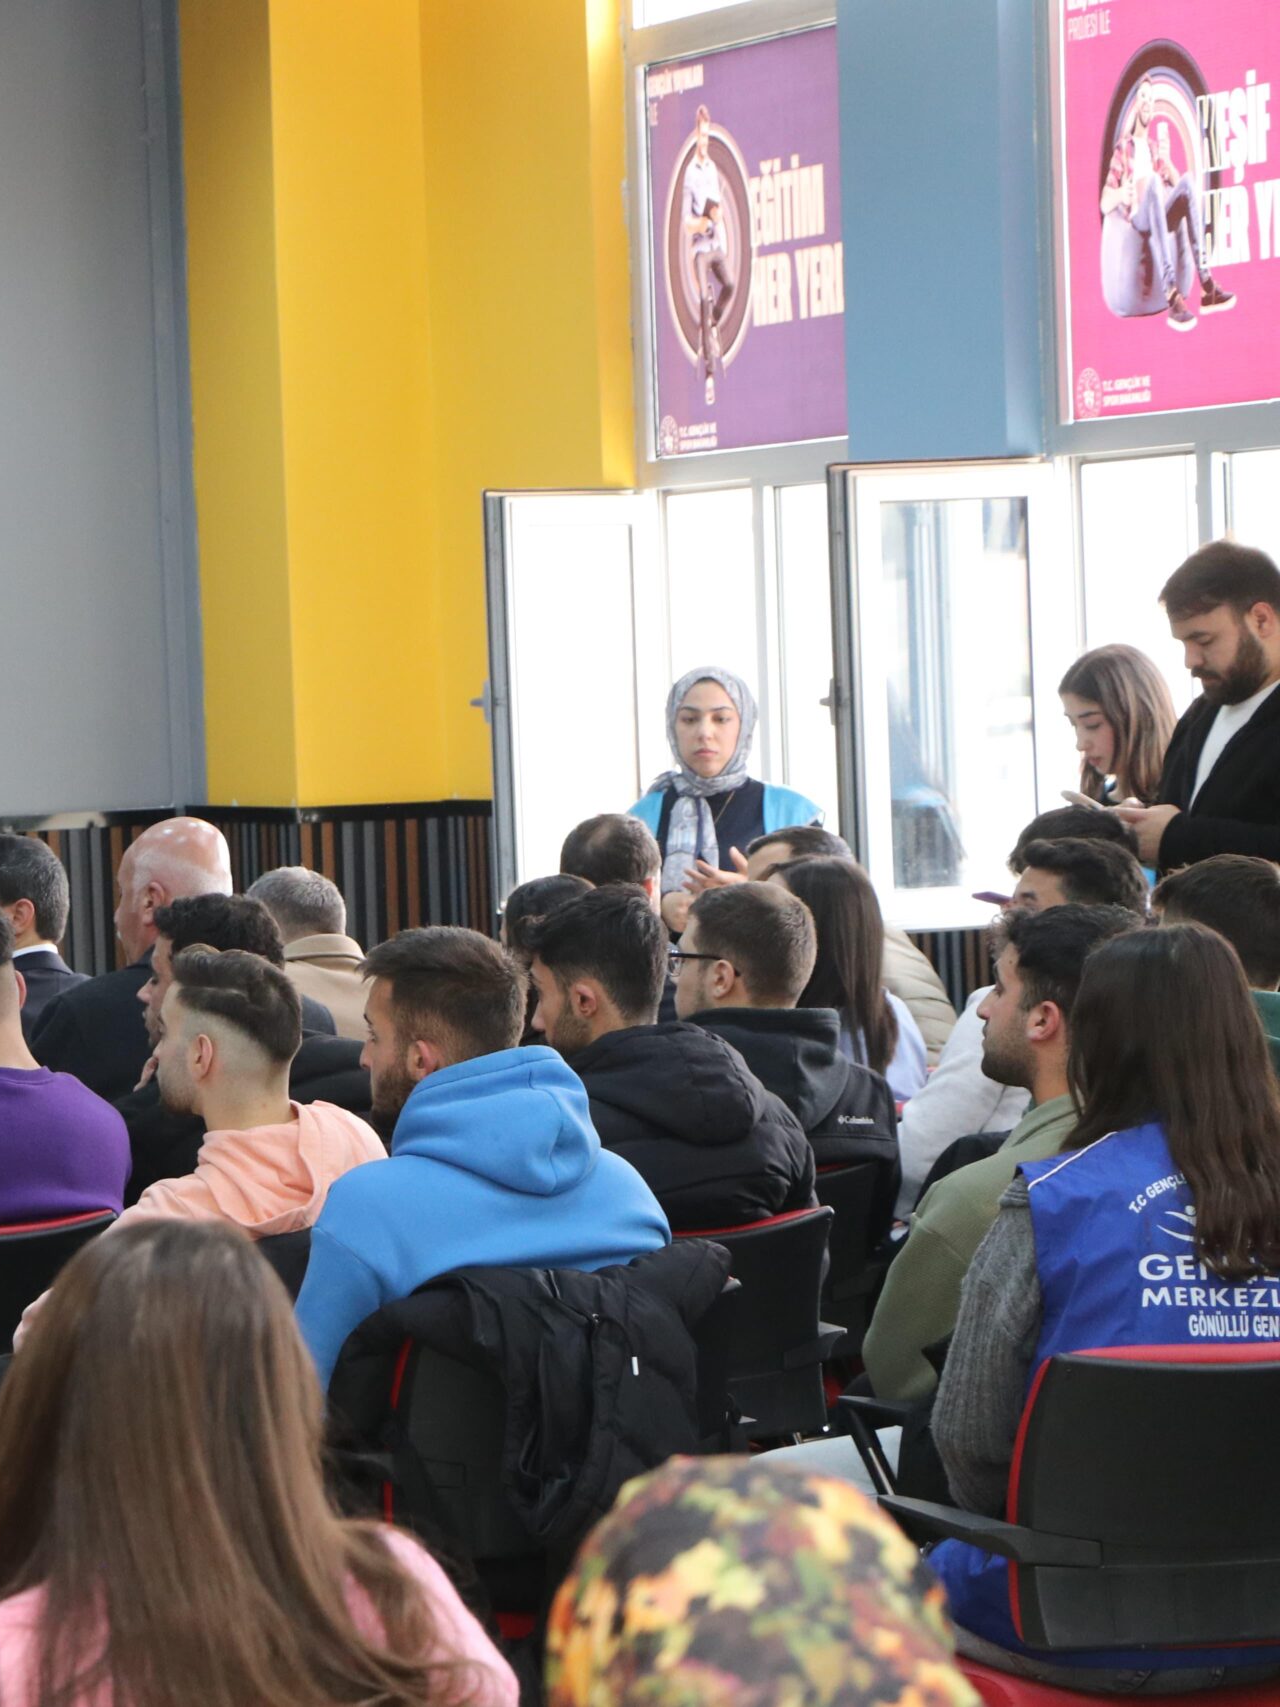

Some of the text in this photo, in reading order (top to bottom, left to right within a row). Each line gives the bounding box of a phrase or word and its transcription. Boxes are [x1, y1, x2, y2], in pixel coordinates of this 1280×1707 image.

[1196, 69, 1271, 184] KEŞİF
[749, 153, 825, 247] EĞİTİM
[1199, 185, 1251, 269] HER
[752, 251, 793, 328] HER
[1128, 1194, 1147, 1214] T.C
[1188, 1309, 1250, 1338] GÖNÜLLÜ
